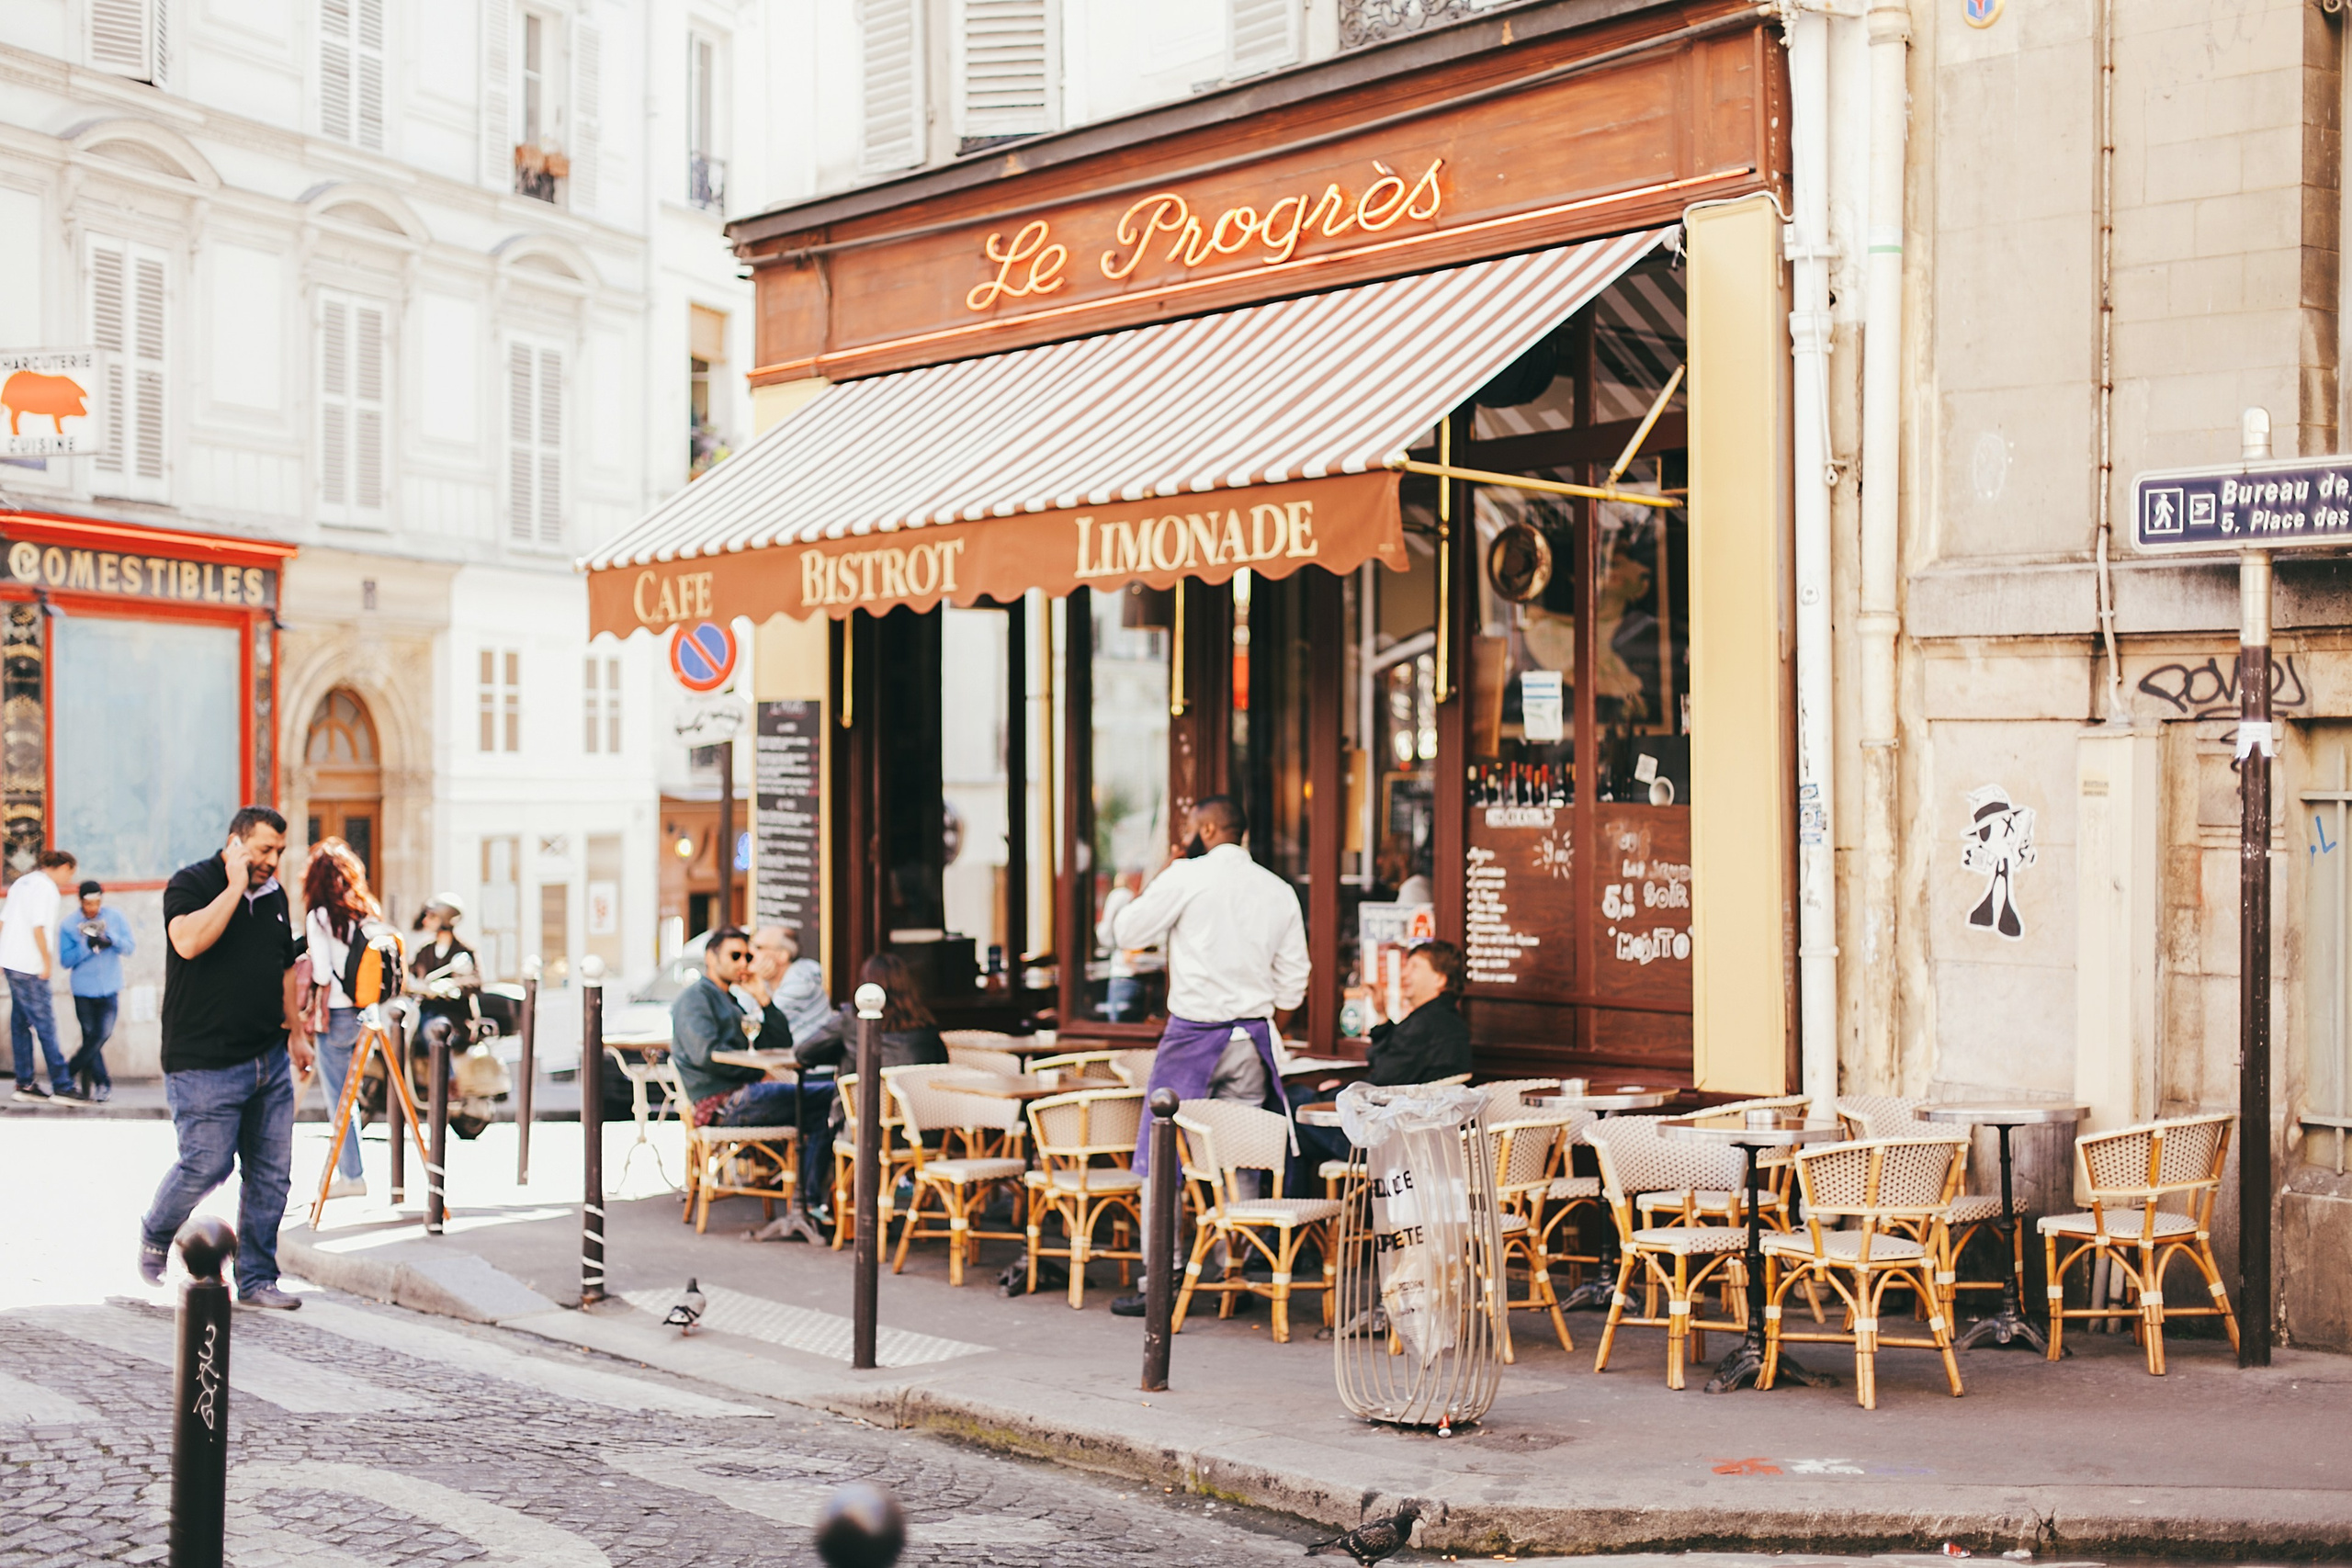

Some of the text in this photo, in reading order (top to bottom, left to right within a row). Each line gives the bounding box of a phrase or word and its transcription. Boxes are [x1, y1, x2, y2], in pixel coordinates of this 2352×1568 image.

[966, 158, 1444, 310] Le Progrès
[8, 436, 75, 454] CUISINE
[2222, 472, 2349, 506] Bureau de
[2249, 509, 2306, 532] Place
[2313, 506, 2349, 527] des
[7, 541, 265, 606] COMESTIBLES
[799, 537, 965, 607] BISTROT
[1074, 500, 1318, 579] LIMONADE
